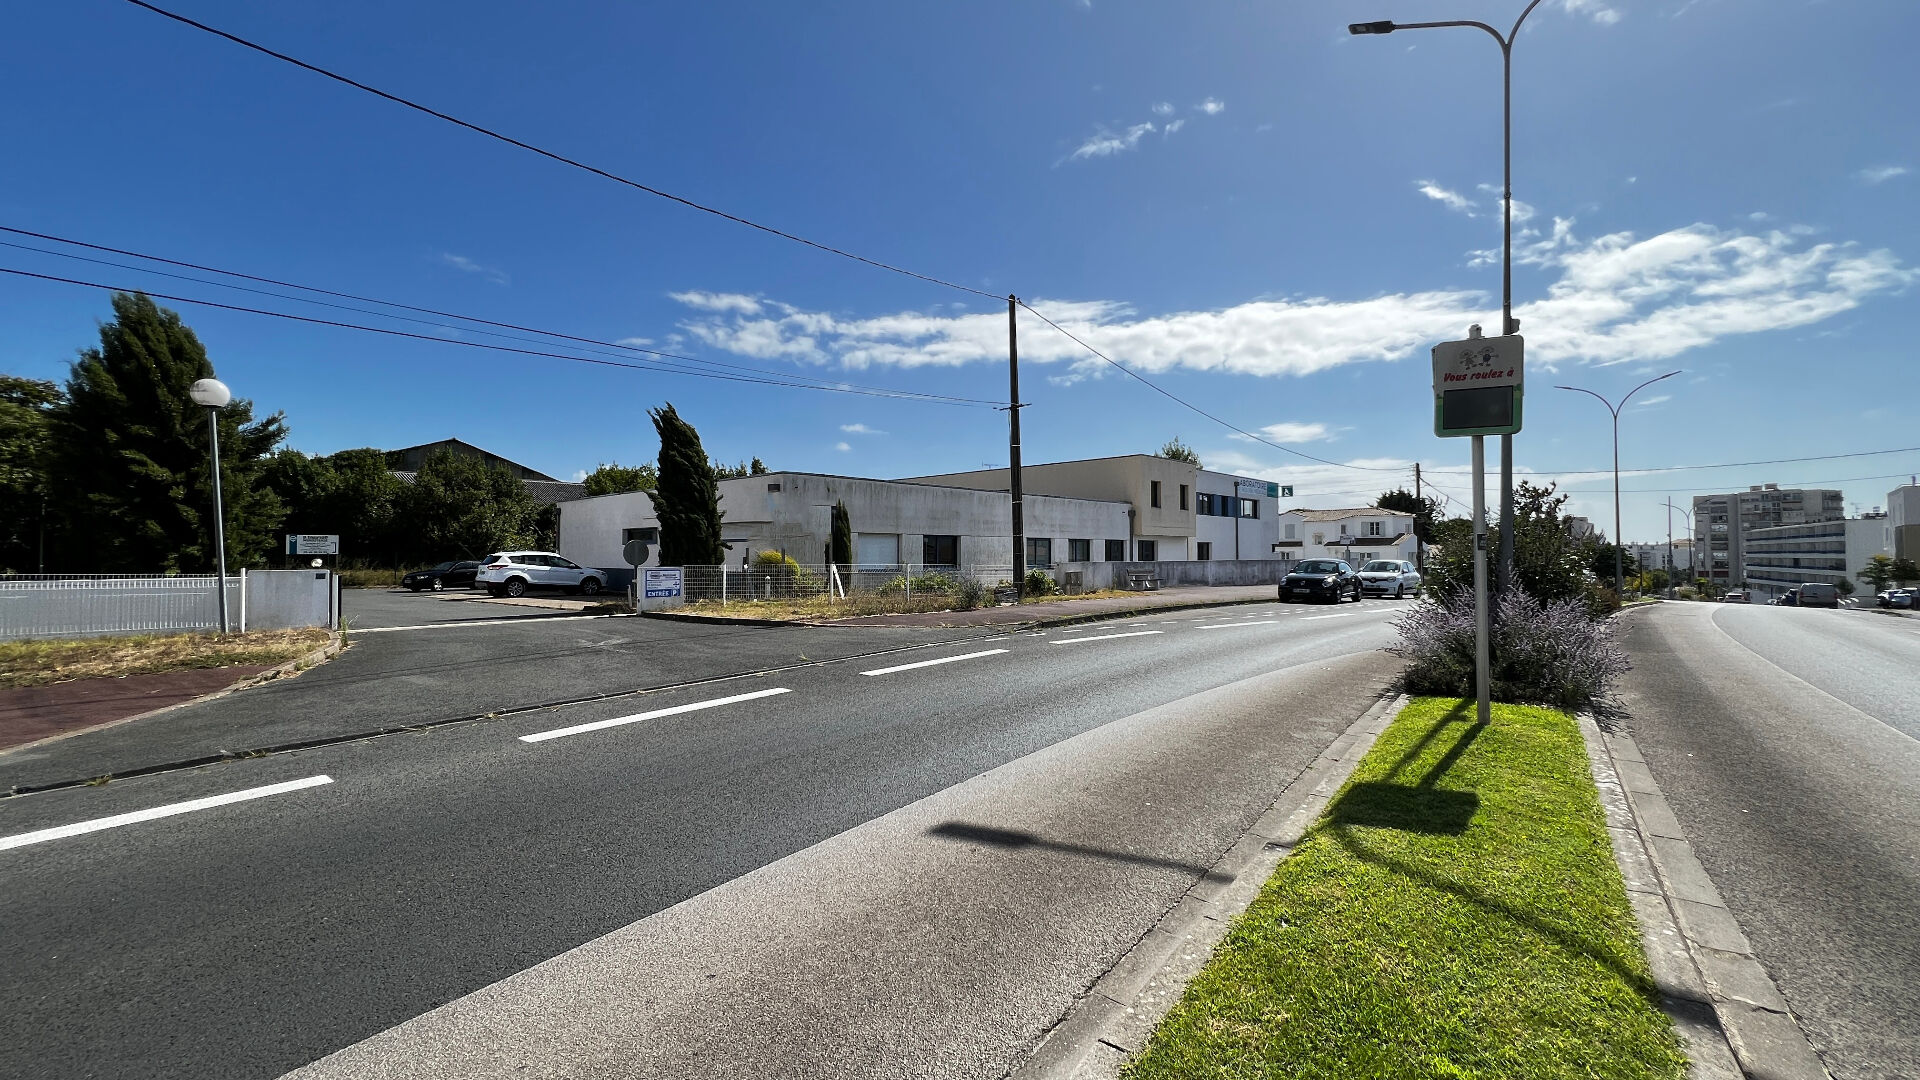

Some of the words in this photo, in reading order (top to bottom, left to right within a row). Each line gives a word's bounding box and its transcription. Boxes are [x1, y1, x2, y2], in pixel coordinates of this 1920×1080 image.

[1443, 373, 1468, 382] Vous
[1470, 369, 1504, 380] roulez
[1237, 480, 1267, 490] ABORATOIRE
